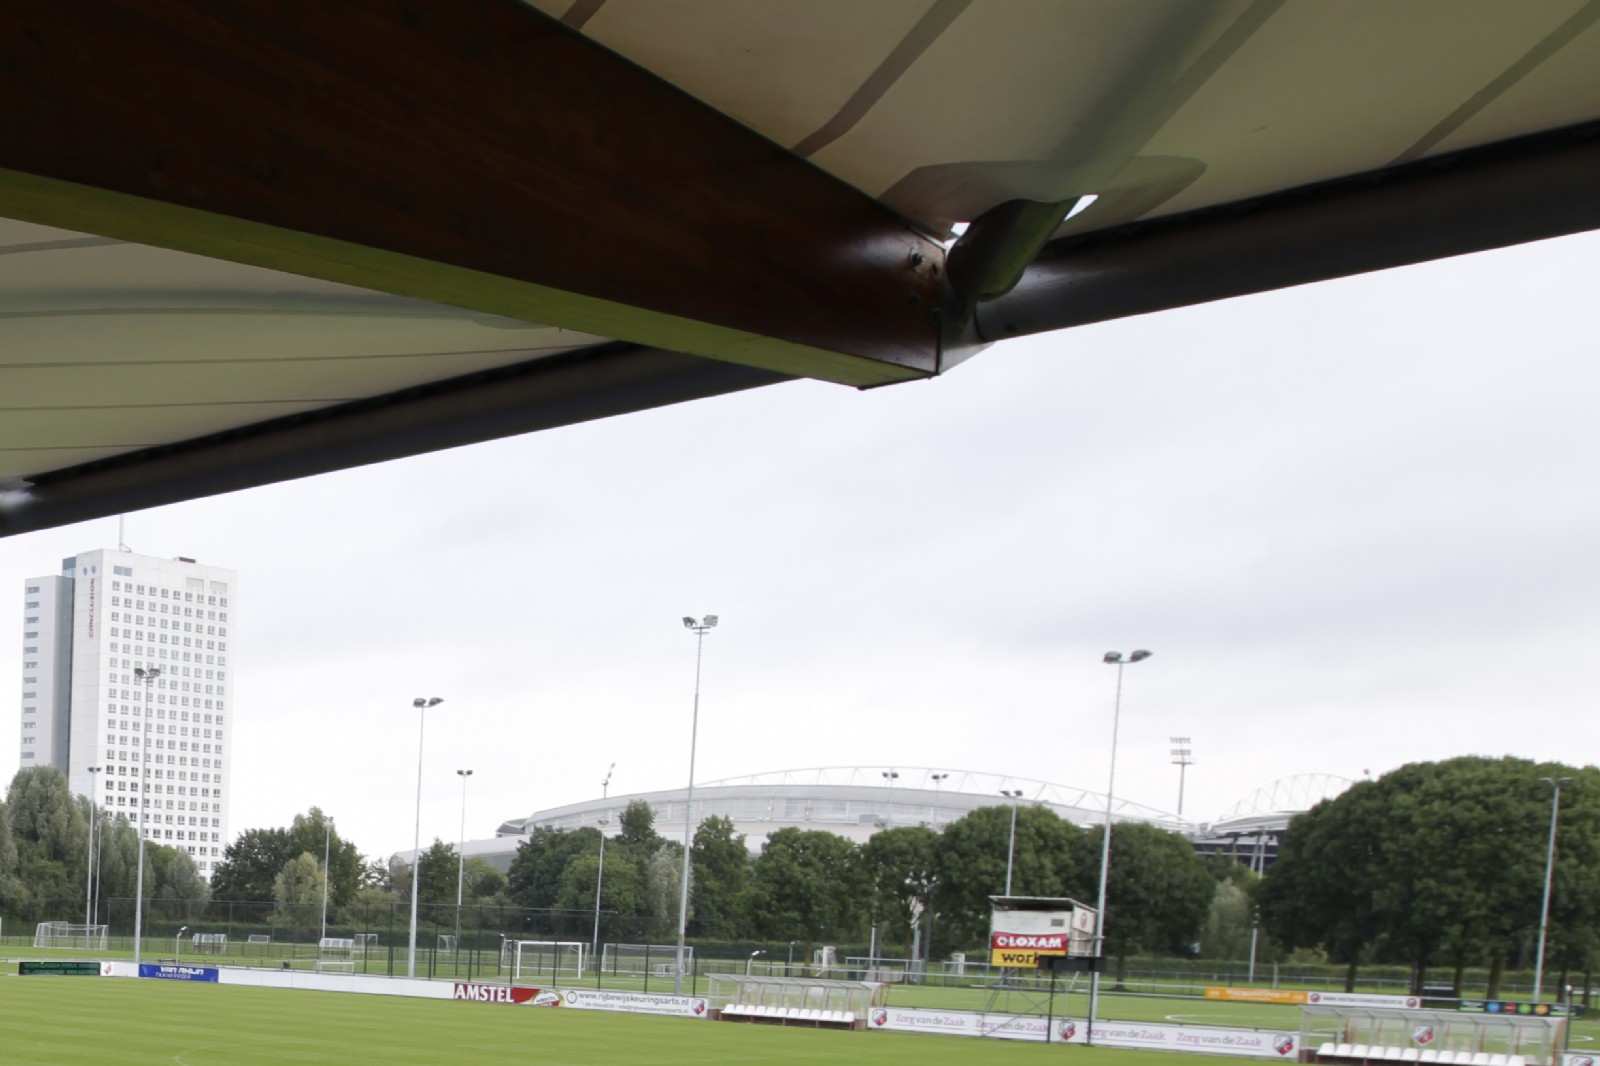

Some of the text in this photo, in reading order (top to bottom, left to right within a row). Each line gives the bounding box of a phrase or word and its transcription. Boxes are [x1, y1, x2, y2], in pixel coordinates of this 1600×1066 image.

[1009, 936, 1062, 948] LOXAM
[455, 984, 514, 1003] AMSTEL
[896, 1014, 965, 1026] Zorg van de Zaak
[976, 1019, 995, 1030] Zorg
[1016, 1022, 1025, 1031] de
[1109, 1030, 1128, 1038] van
[1128, 1029, 1139, 1038] de
[1141, 1030, 1165, 1040] Zaak
[1176, 1032, 1201, 1044] Zorg
[1222, 1035, 1234, 1044] de
[1235, 1037, 1262, 1047] Zaak
